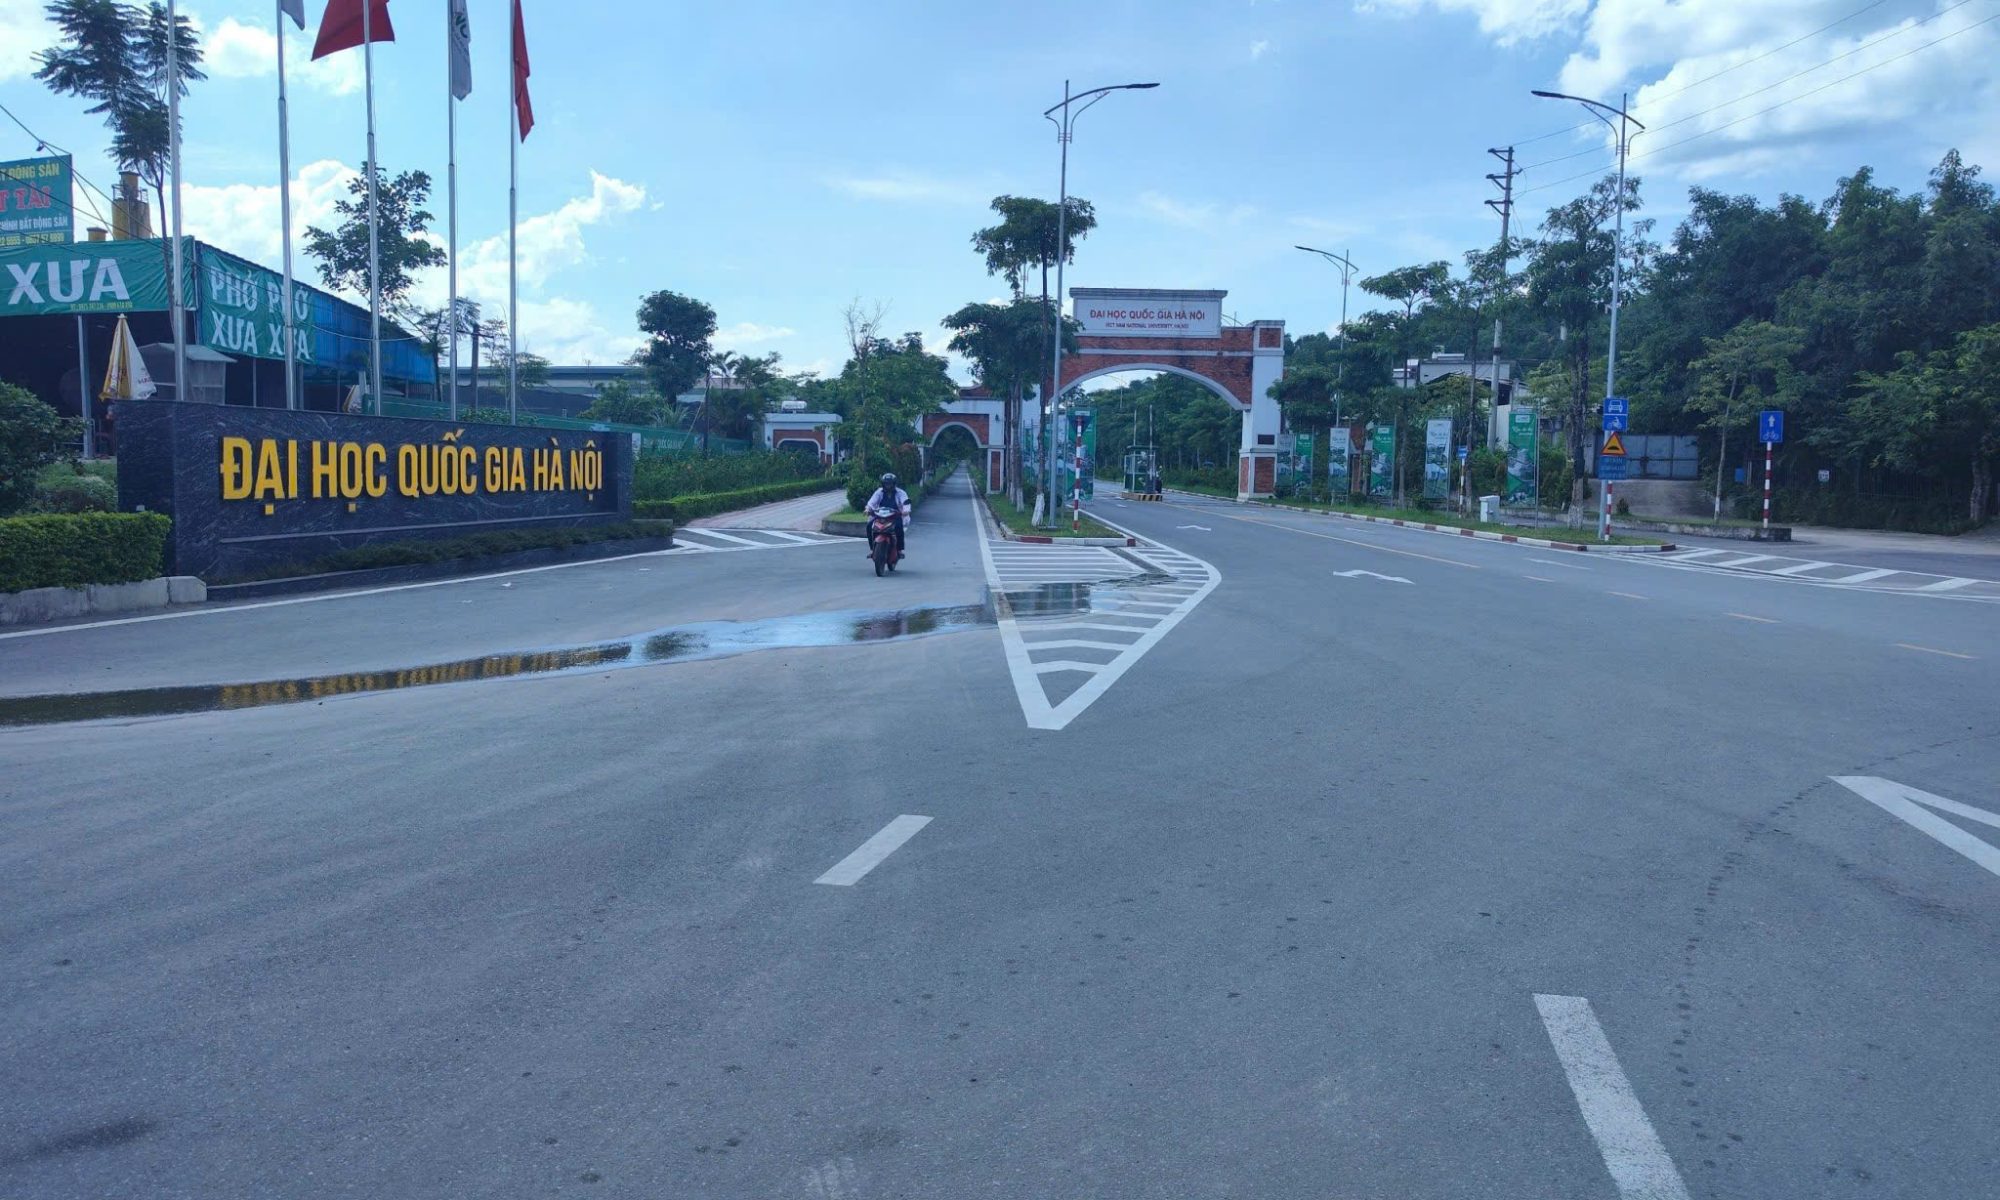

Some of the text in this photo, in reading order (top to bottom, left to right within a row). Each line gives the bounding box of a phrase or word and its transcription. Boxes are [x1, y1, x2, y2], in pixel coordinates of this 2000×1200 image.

[38, 160, 60, 177] SẢN
[14, 181, 52, 209] TÀI
[5, 257, 131, 305] XƯA
[209, 266, 259, 311] PHỞ
[210, 311, 259, 354] XƯA
[1090, 308, 1205, 321] ĐẠI HỌC QUỐC GIA HÀ NỘI
[220, 428, 603, 515] ĐẠI HỌC QUỐC GIA HÀ NỘI
